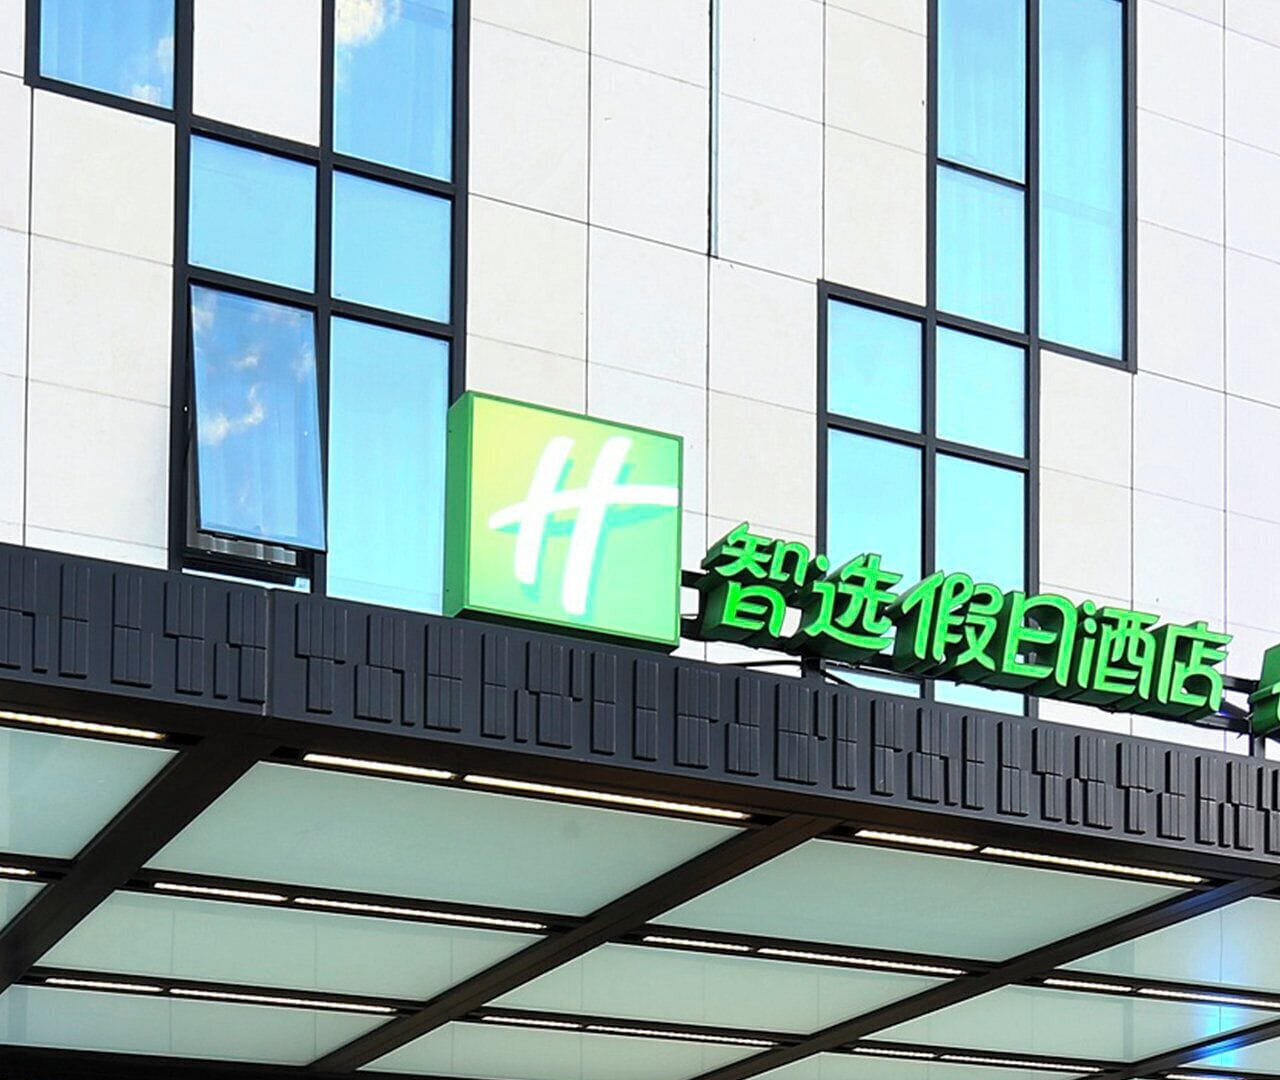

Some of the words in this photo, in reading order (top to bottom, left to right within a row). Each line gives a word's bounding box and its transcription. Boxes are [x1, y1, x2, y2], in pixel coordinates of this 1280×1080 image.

[714, 521, 1234, 712] 智选假日酒店
